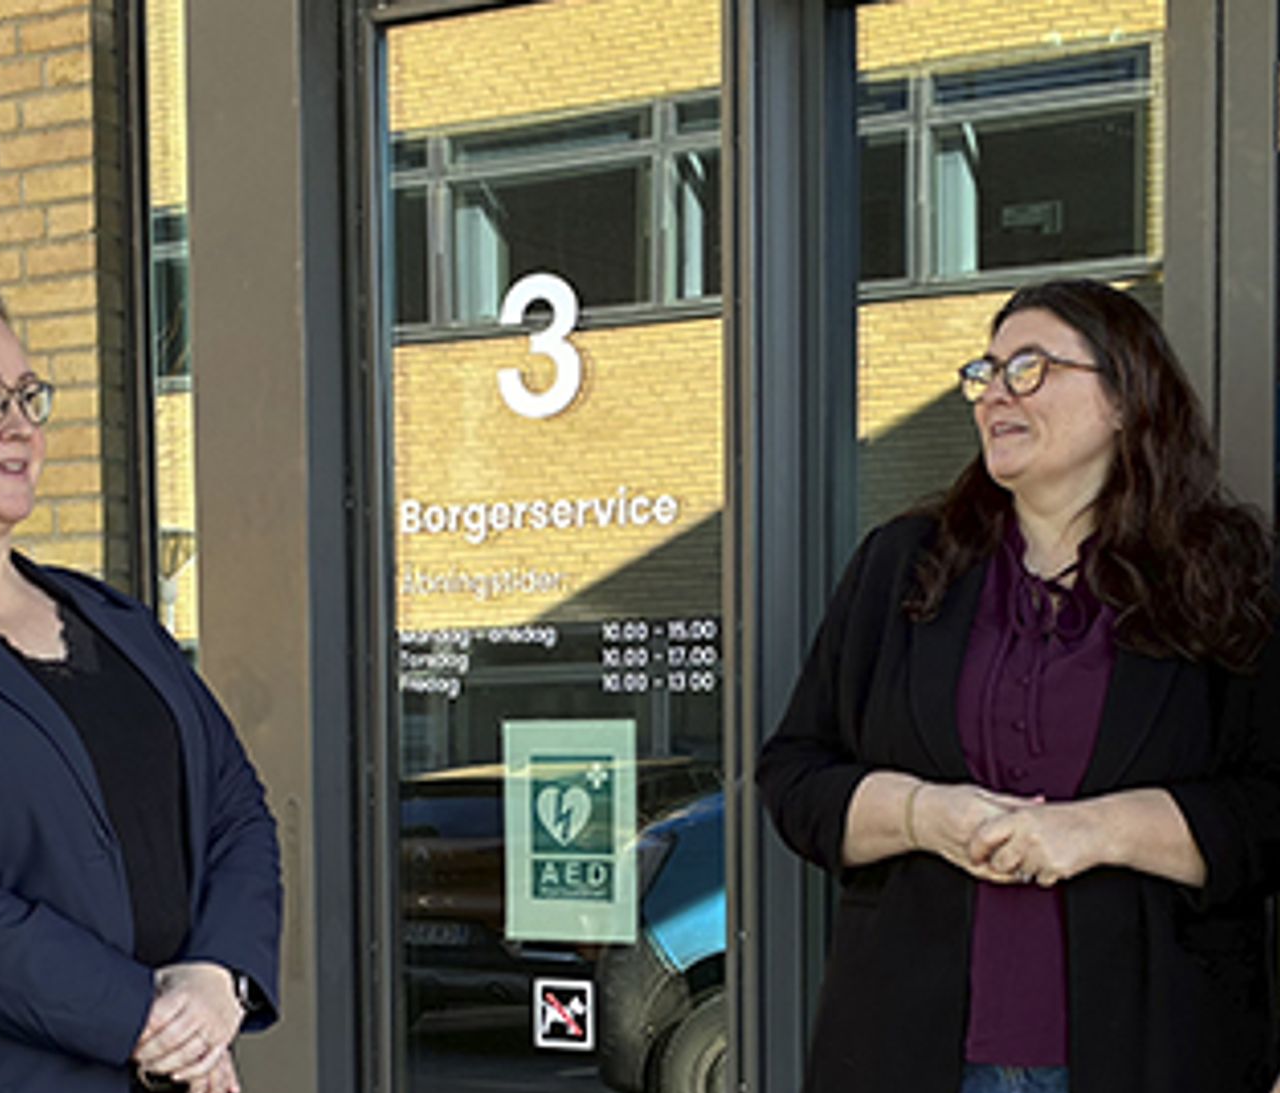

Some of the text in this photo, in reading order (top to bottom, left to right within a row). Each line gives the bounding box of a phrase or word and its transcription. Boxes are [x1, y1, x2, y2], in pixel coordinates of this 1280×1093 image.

[497, 272, 582, 419] 3
[401, 487, 678, 543] Borgerservice
[540, 860, 608, 888] AED
